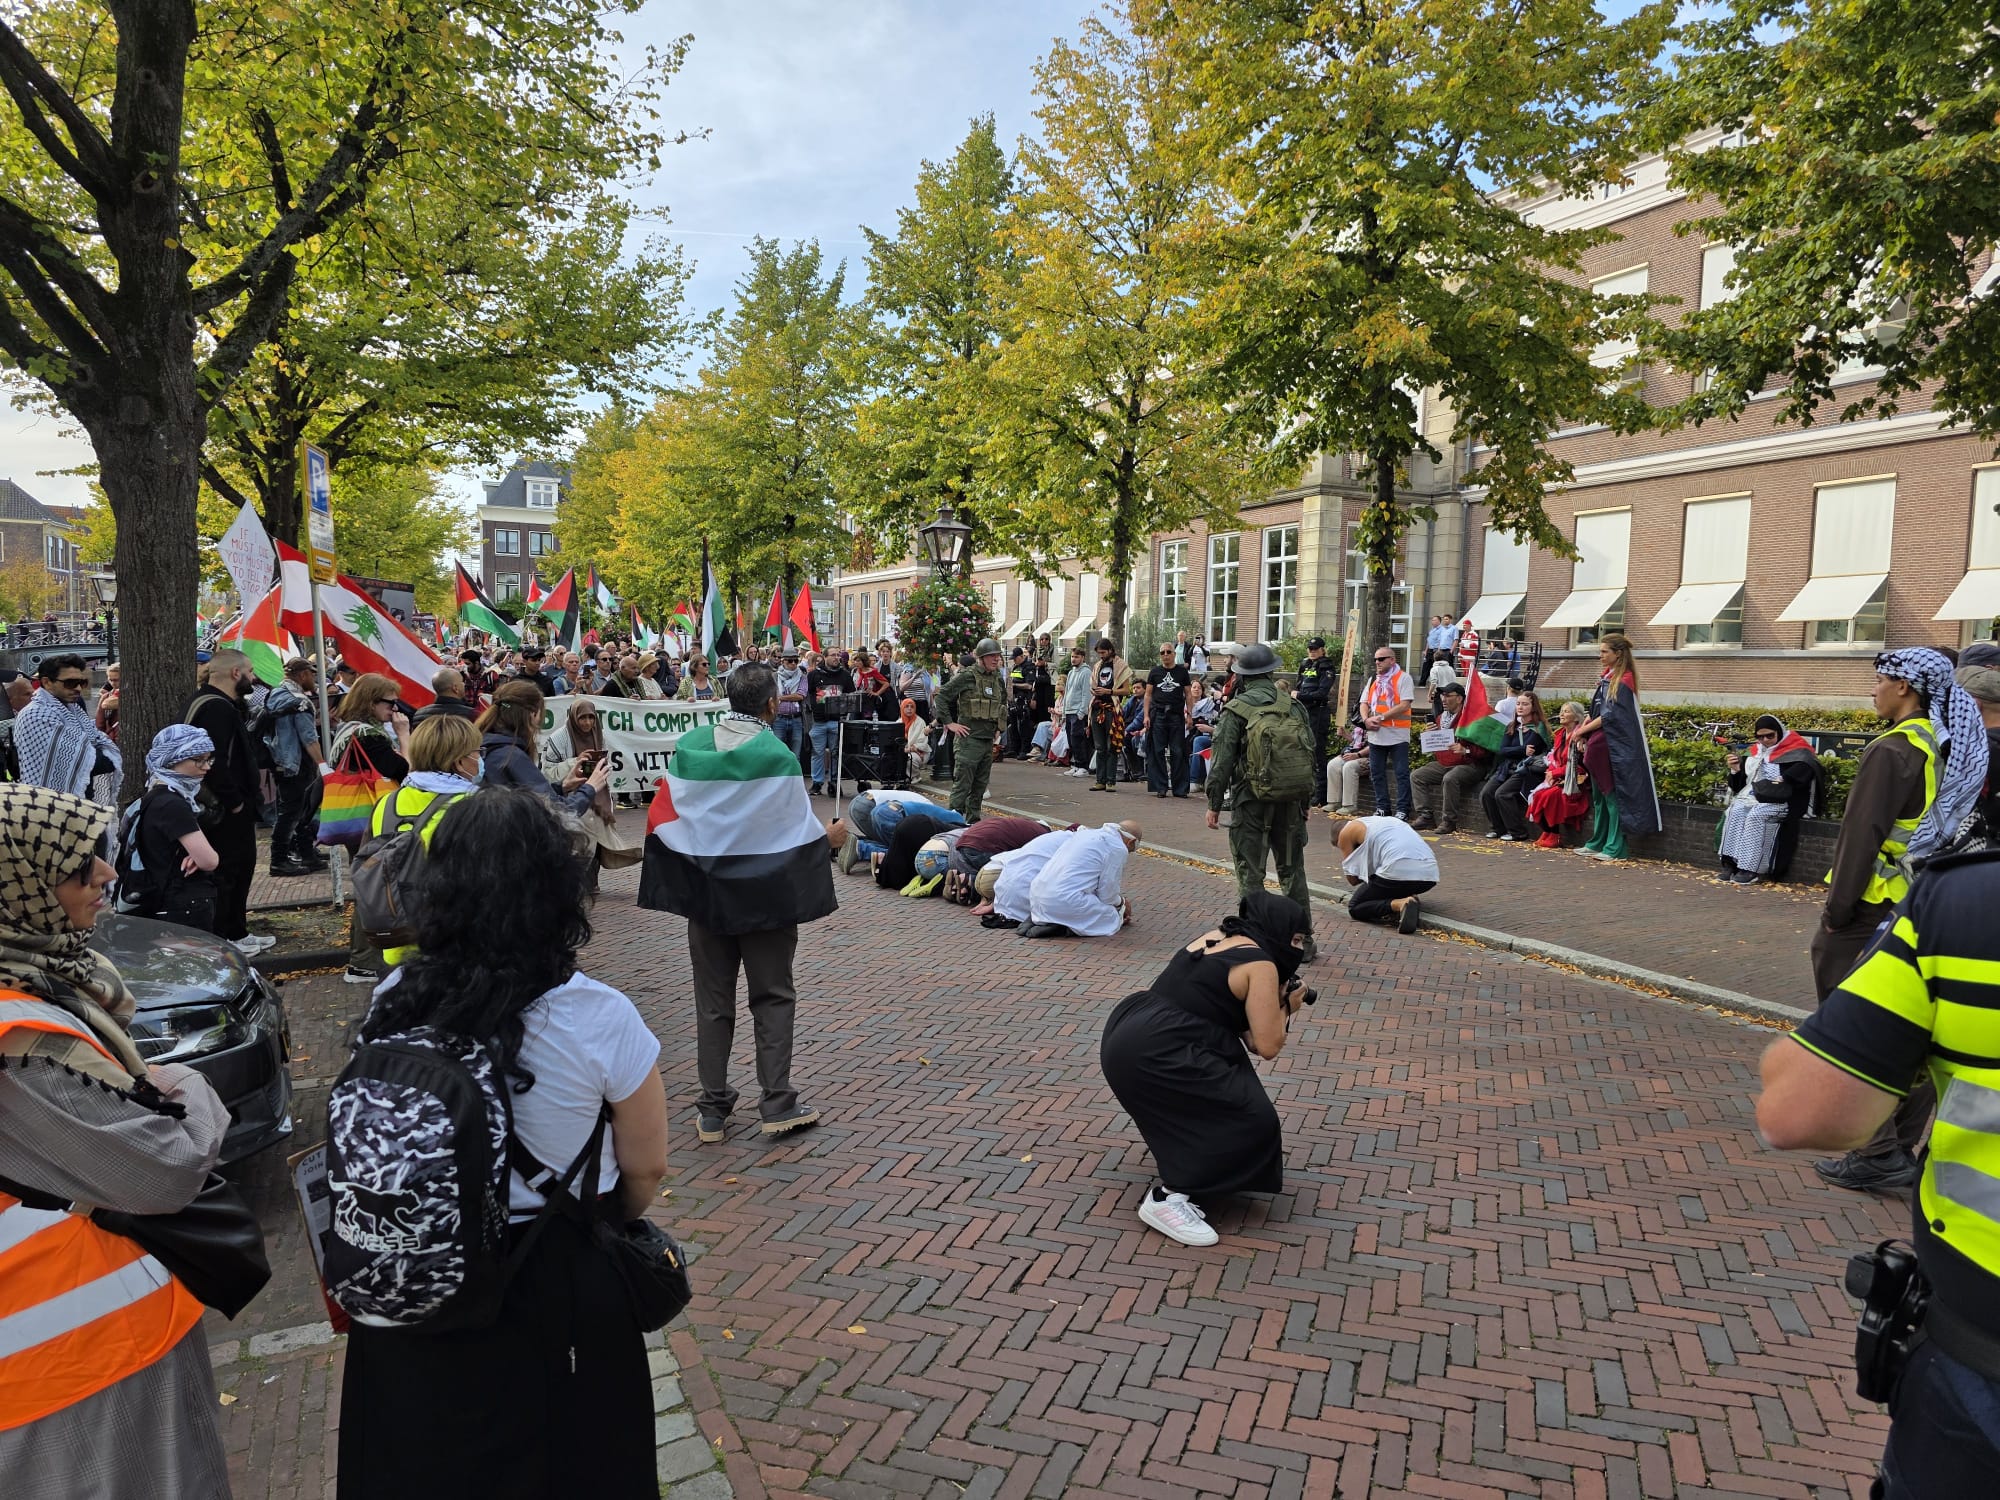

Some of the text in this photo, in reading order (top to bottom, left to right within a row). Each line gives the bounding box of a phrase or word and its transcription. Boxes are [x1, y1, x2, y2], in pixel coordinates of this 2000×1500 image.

[240, 528, 248, 540] IF
[231, 538, 254, 553] MUST
[227, 551, 242, 565] YOU
[246, 555, 263, 571] MUST
[233, 566, 244, 578] TO
[634, 750, 677, 771] WIT
